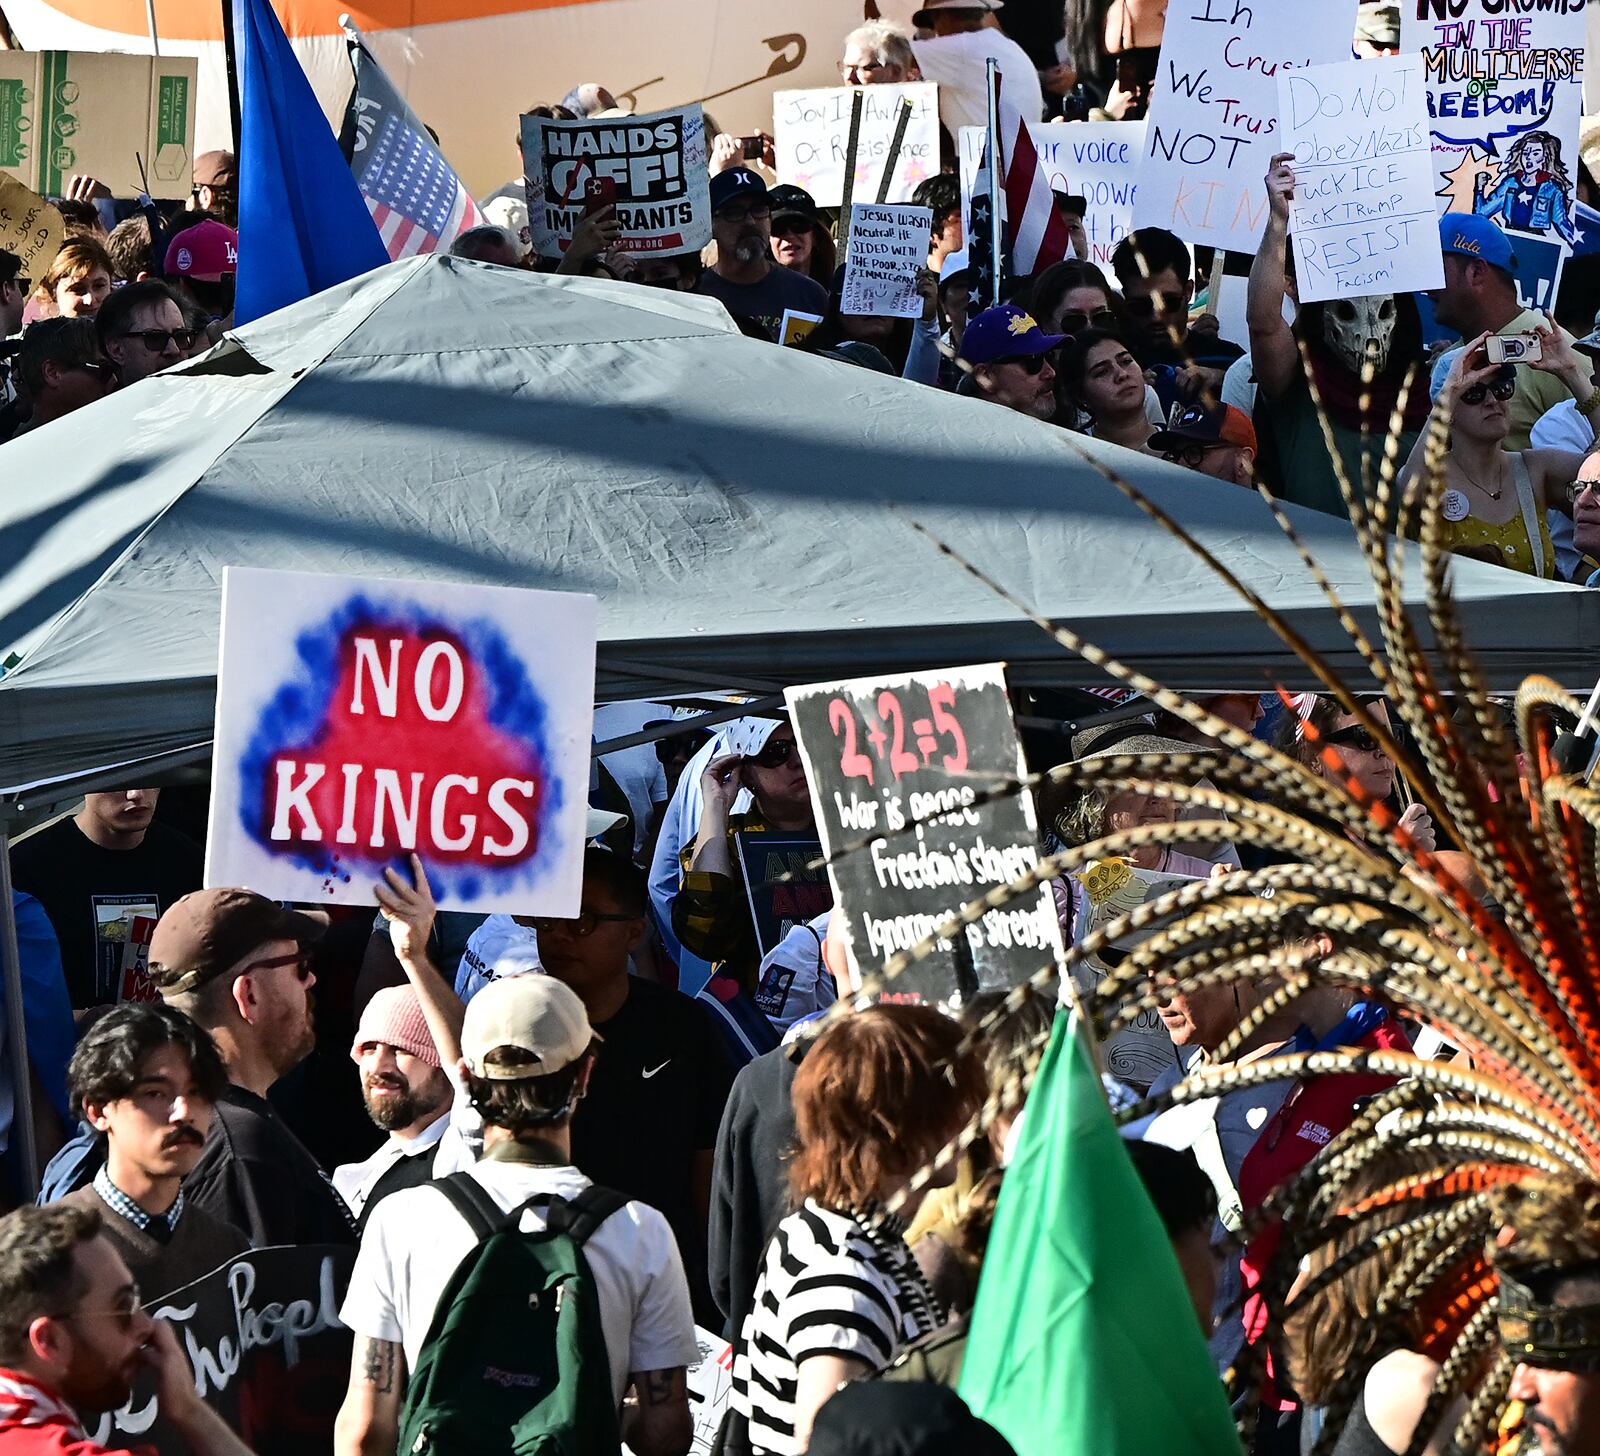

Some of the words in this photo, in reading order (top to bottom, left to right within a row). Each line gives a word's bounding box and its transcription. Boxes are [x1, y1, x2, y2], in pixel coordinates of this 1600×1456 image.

[1433, 19, 1476, 49] IN
[1480, 17, 1533, 50] THE
[1169, 59, 1213, 104] We
[1421, 46, 1586, 84] MULTIVERSE
[1425, 81, 1556, 120] REEDOM!
[1466, 79, 1498, 99] OF
[784, 97, 827, 127] Joy
[1215, 98, 1277, 135] Trus
[547, 122, 678, 157] HANDS
[830, 133, 932, 163] Rsistnce
[1072, 139, 1129, 164] voice
[1150, 125, 1253, 170] NOT
[551, 150, 681, 201] OFF!
[1351, 163, 1408, 193] ICE
[545, 201, 693, 234] IMRANTS
[859, 208, 894, 224] Jesus
[1171, 175, 1269, 234] KIN
[851, 240, 889, 254] SIDED
[890, 245, 918, 257] WITH
[898, 228, 912, 241] HE
[224, 241, 239, 264] LA
[851, 255, 871, 268] THE
[1298, 220, 1418, 291] RESIST
[349, 636, 466, 724] NO
[269, 758, 536, 859] KINGS
[833, 790, 880, 831] War
[882, 787, 906, 831] is
[228, 1255, 348, 1370] Peopl
